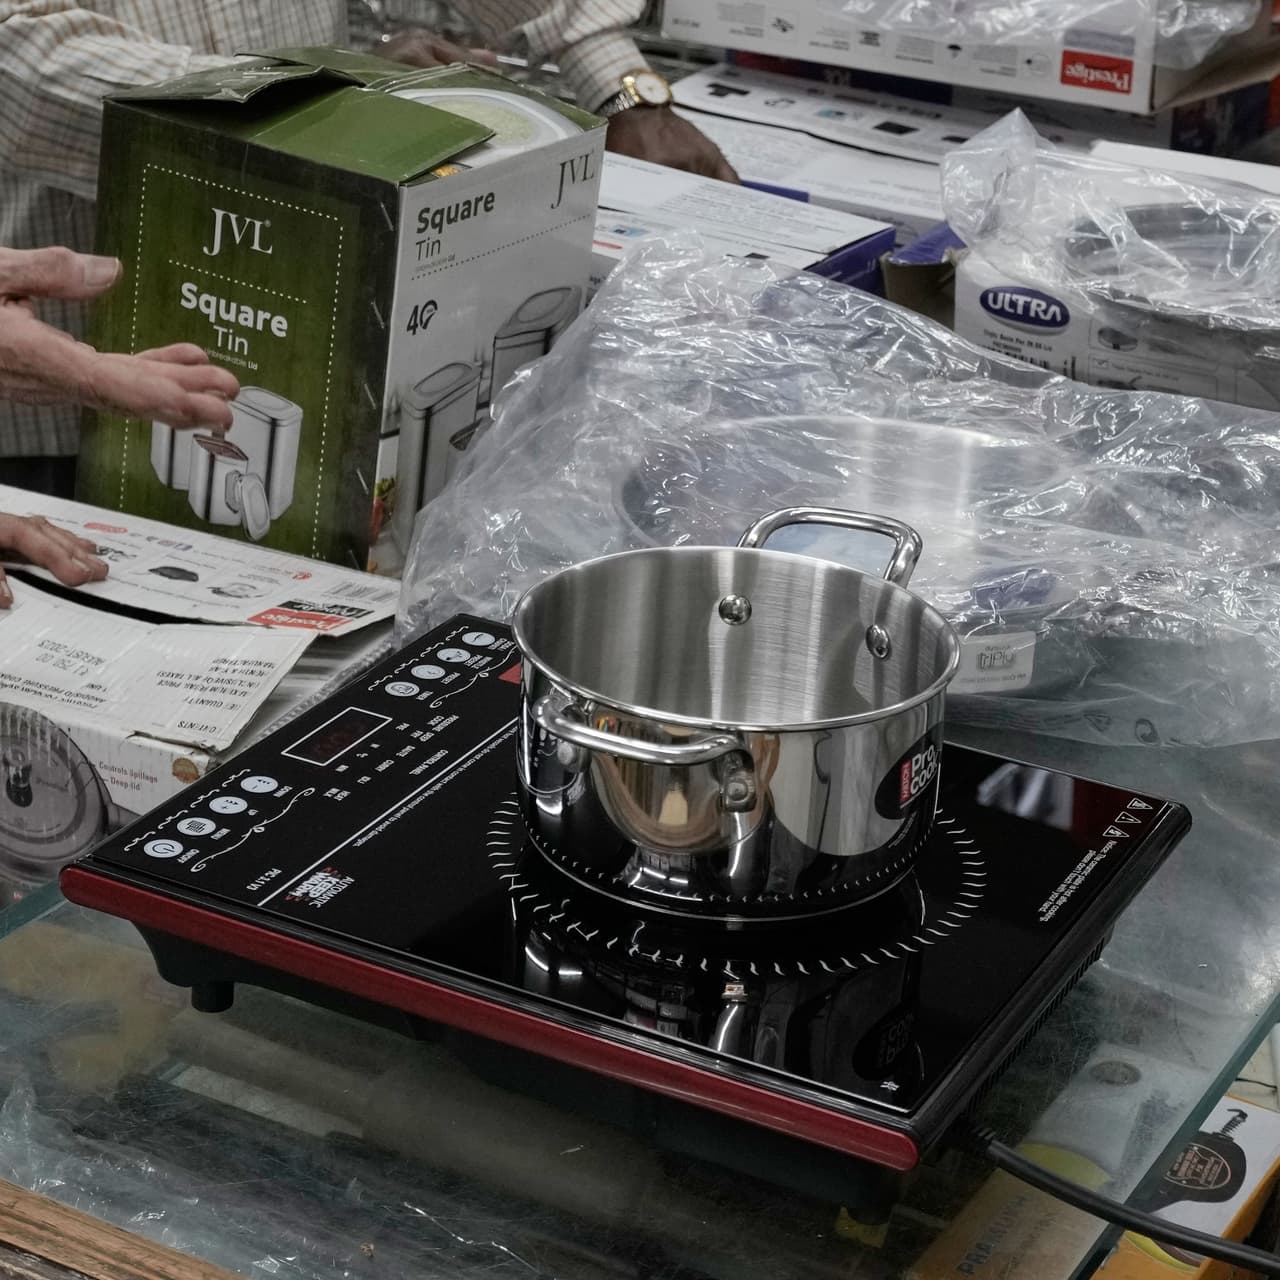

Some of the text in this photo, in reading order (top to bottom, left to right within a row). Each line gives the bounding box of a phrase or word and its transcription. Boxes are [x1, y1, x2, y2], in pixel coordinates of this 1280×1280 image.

[1063, 62, 1131, 90] Prestige
[551, 153, 595, 210] JVL
[416, 191, 496, 235] Square
[202, 206, 273, 257] JVL
[415, 236, 442, 261] Tin
[179, 281, 289, 338] Square
[987, 291, 1062, 323] ULTRA
[212, 324, 249, 356] Tin
[371, 758, 396, 772] CURRY
[421, 749, 450, 765] CONTROL
[912, 744, 935, 778] Pro
[270, 785, 293, 797] DOWN
[208, 827, 232, 840] MENU
[174, 848, 201, 863] ON/OFF
[263, 867, 282, 877] PIC
[286, 870, 331, 896] WARM
[303, 876, 340, 897] KEEP
[306, 876, 357, 907] AUTOMATIC
